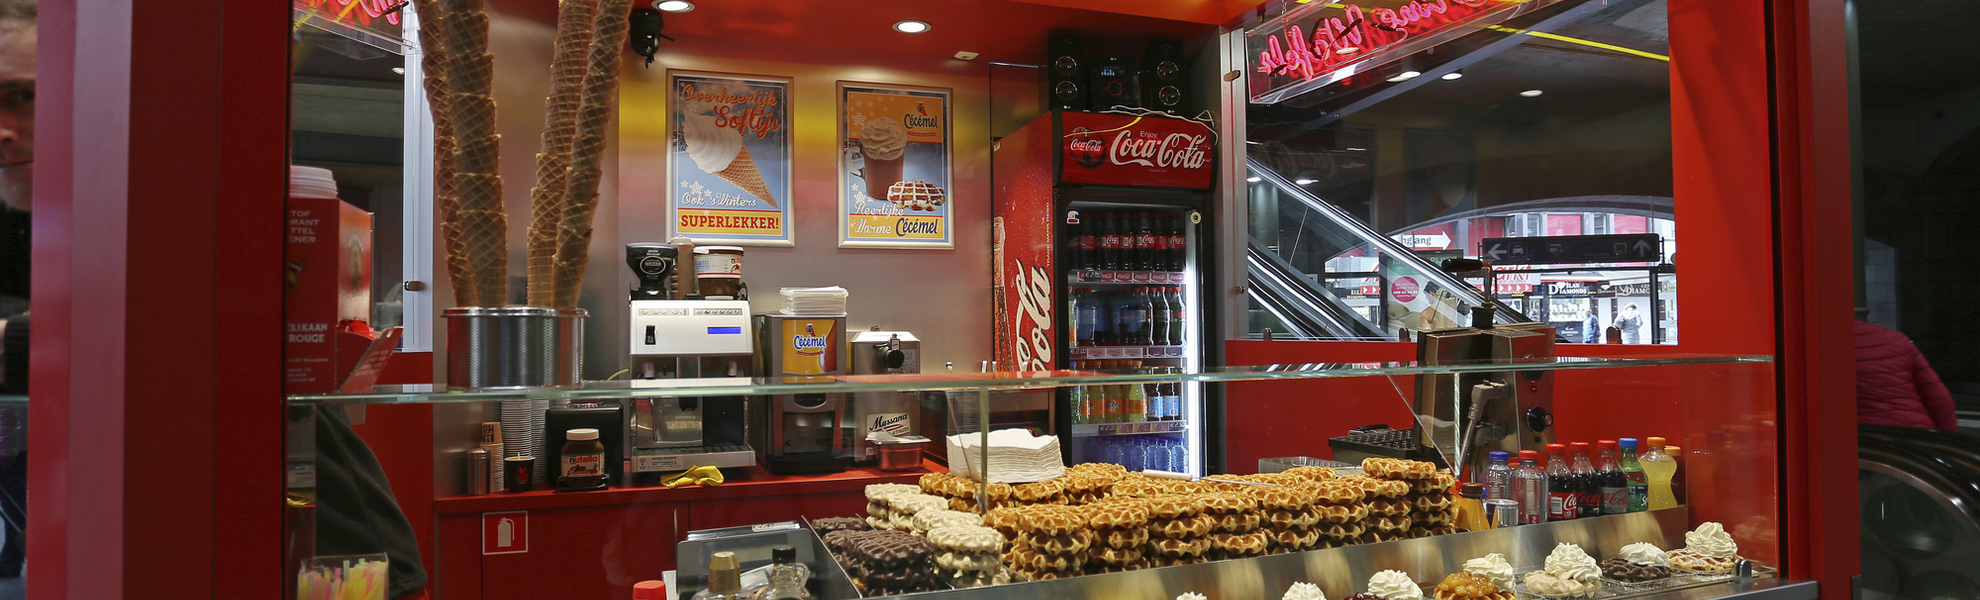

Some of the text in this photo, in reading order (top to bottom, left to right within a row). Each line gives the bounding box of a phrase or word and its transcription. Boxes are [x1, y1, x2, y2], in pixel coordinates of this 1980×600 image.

[681, 83, 778, 110] Overheerlijk
[713, 105, 781, 139] Softijs
[904, 113, 938, 129] Cécémel
[1140, 130, 1158, 139] Enjoy
[1109, 130, 1207, 169] Coca-Cola
[682, 192, 706, 206] Ook
[716, 193, 757, 207] Winters
[854, 202, 905, 220] Heerlijke
[289, 218, 320, 226] RANT
[680, 214, 779, 230] SUPERLEKKER!
[852, 217, 939, 237] Warme Cécémel
[1403, 236, 1432, 247] ngang
[289, 334, 325, 343] ROUGE
[794, 335, 826, 350] Cécémel
[869, 413, 908, 431] Mussana
[570, 455, 598, 464] nutella
